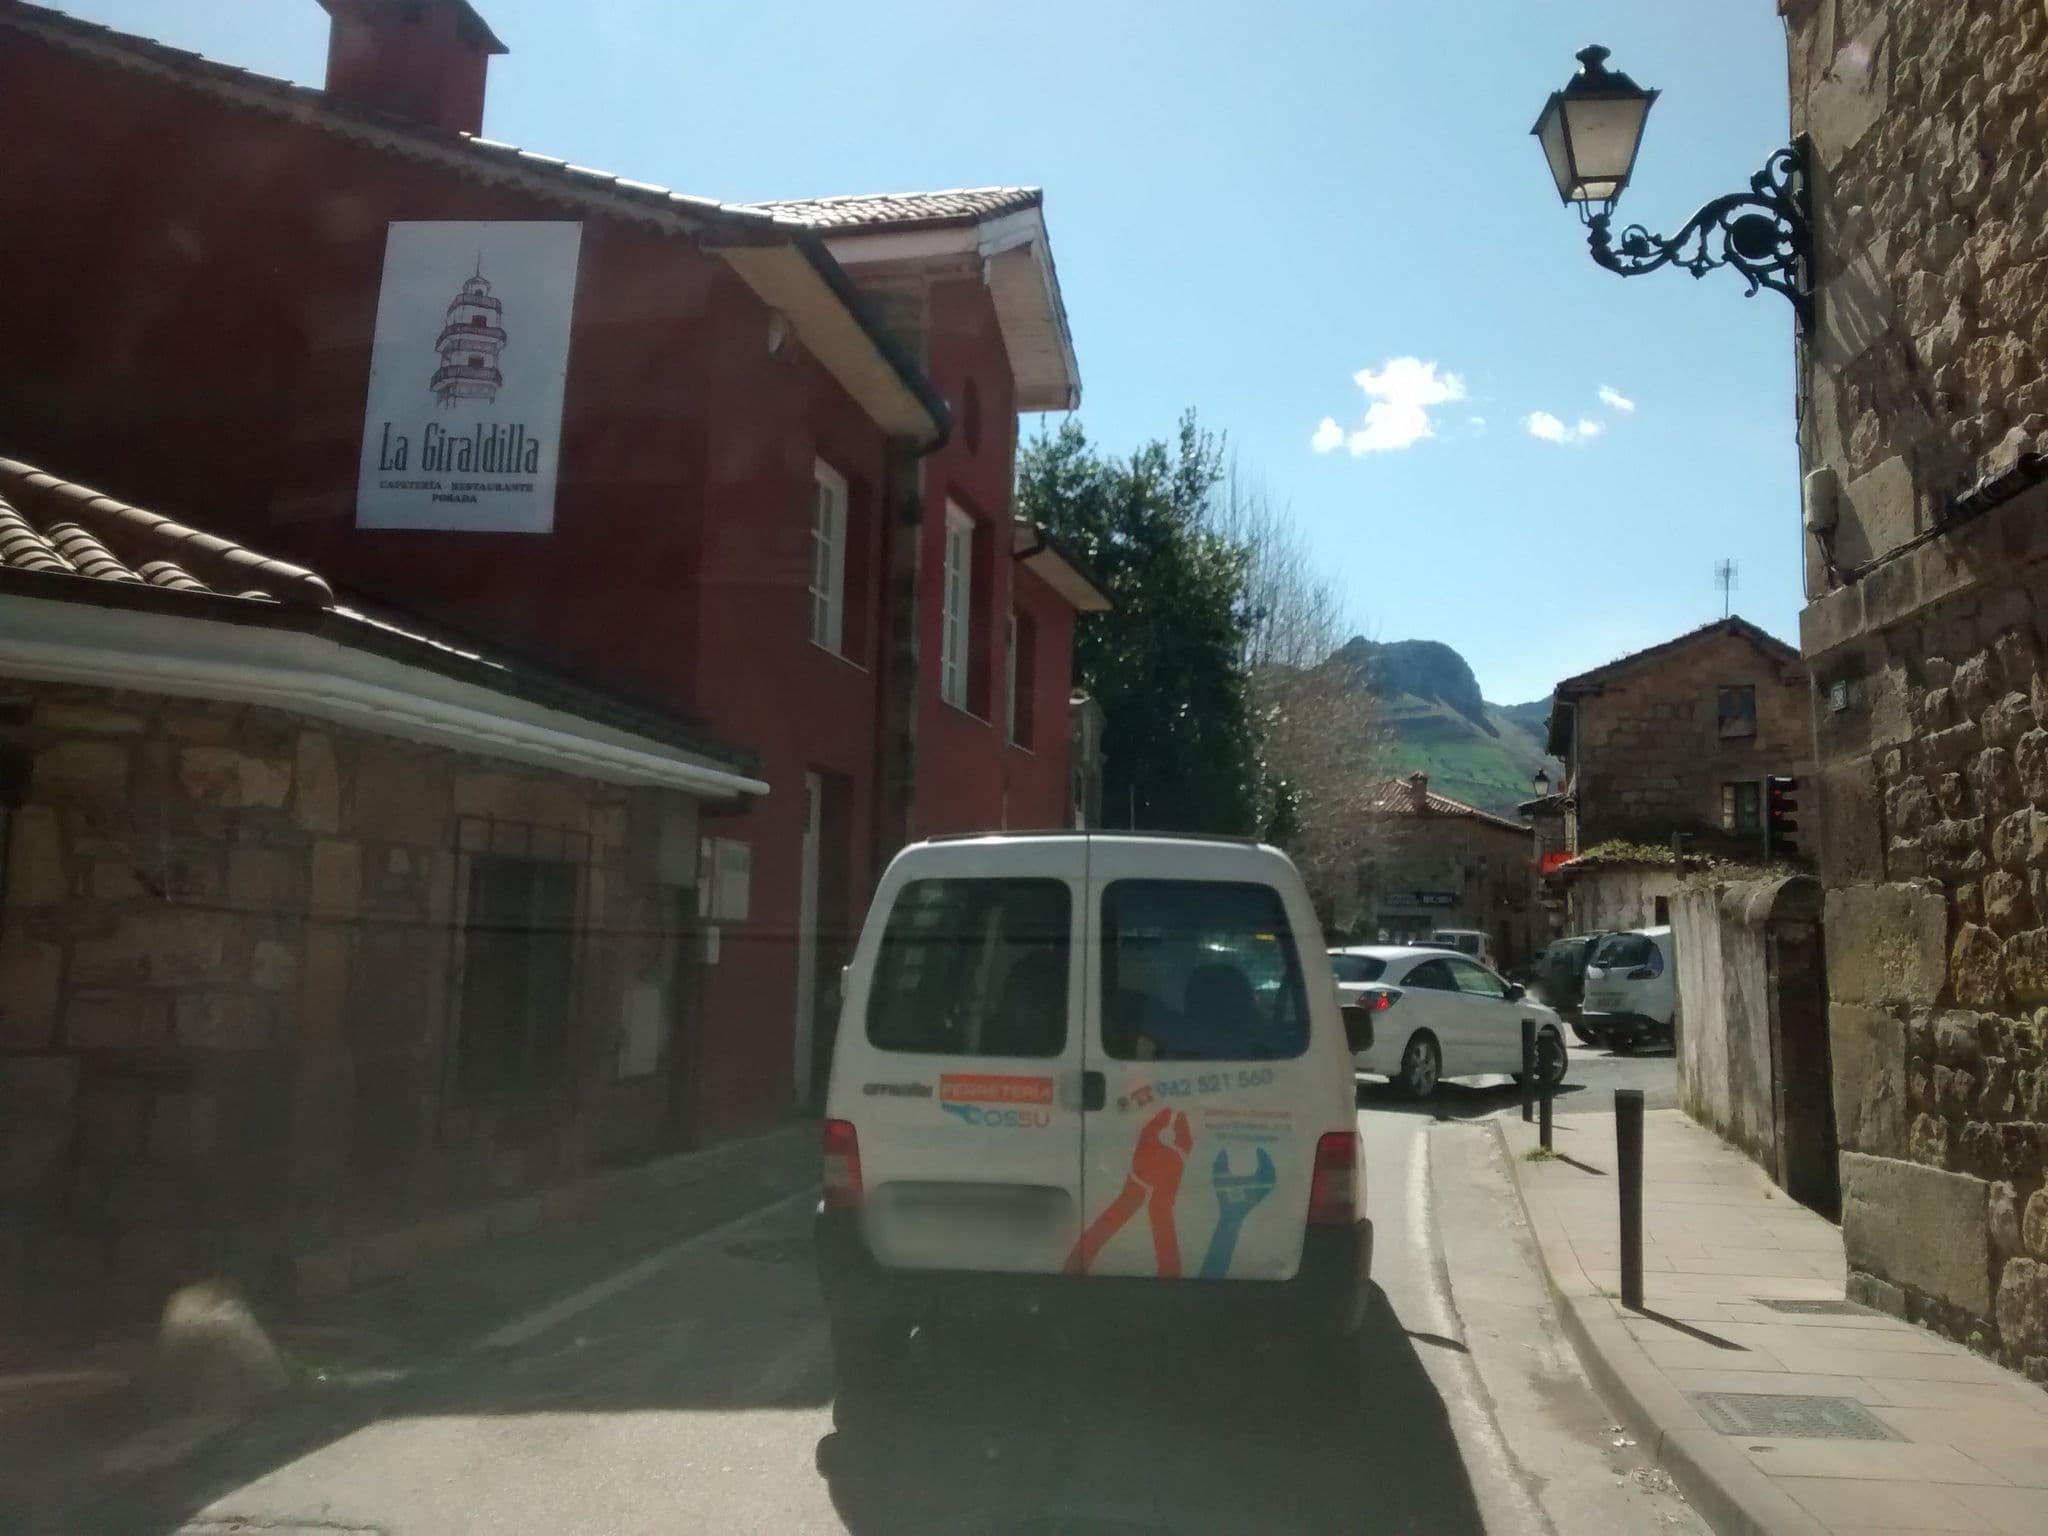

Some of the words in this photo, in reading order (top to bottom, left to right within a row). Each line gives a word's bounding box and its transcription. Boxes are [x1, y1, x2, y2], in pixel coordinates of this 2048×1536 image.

[378, 422, 408, 471] La
[421, 422, 539, 474] Giraldilla
[451, 481, 535, 492] RESTAURANTE
[1198, 1073, 1231, 1093] 521
